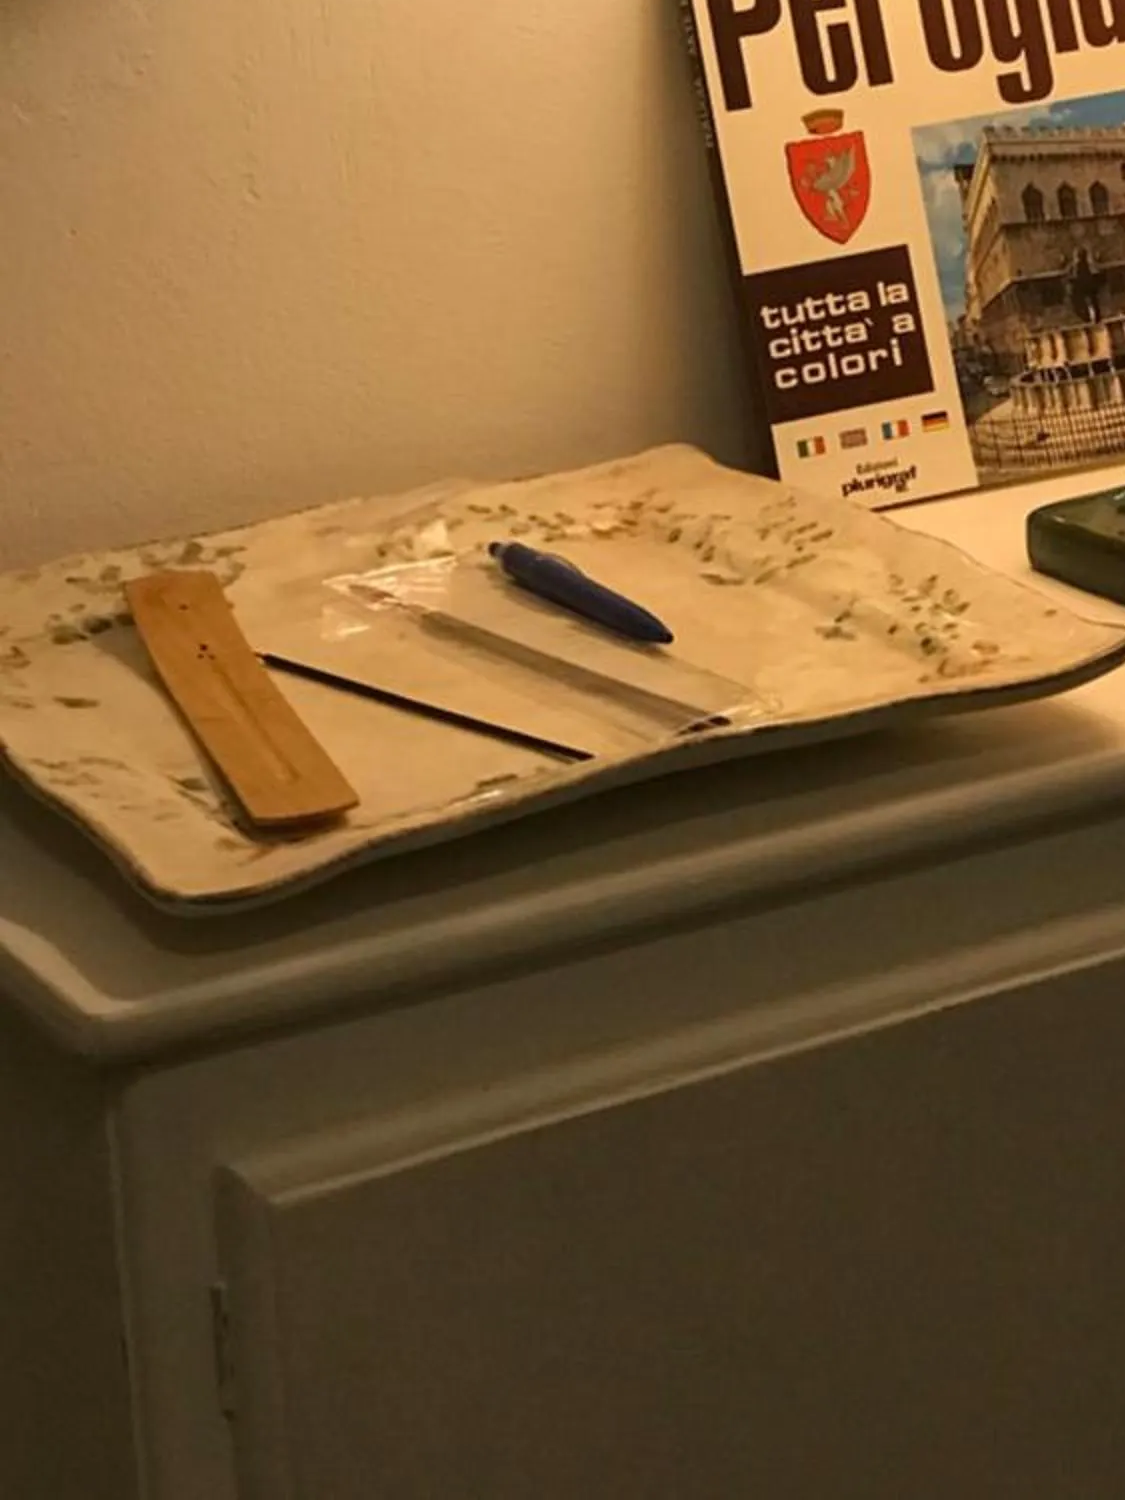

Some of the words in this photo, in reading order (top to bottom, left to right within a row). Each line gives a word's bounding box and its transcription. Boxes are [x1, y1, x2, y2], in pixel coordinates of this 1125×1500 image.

[760, 290, 871, 329] tutta
[877, 281, 909, 307] la
[892, 312, 916, 335] a
[774, 338, 902, 389] colori
